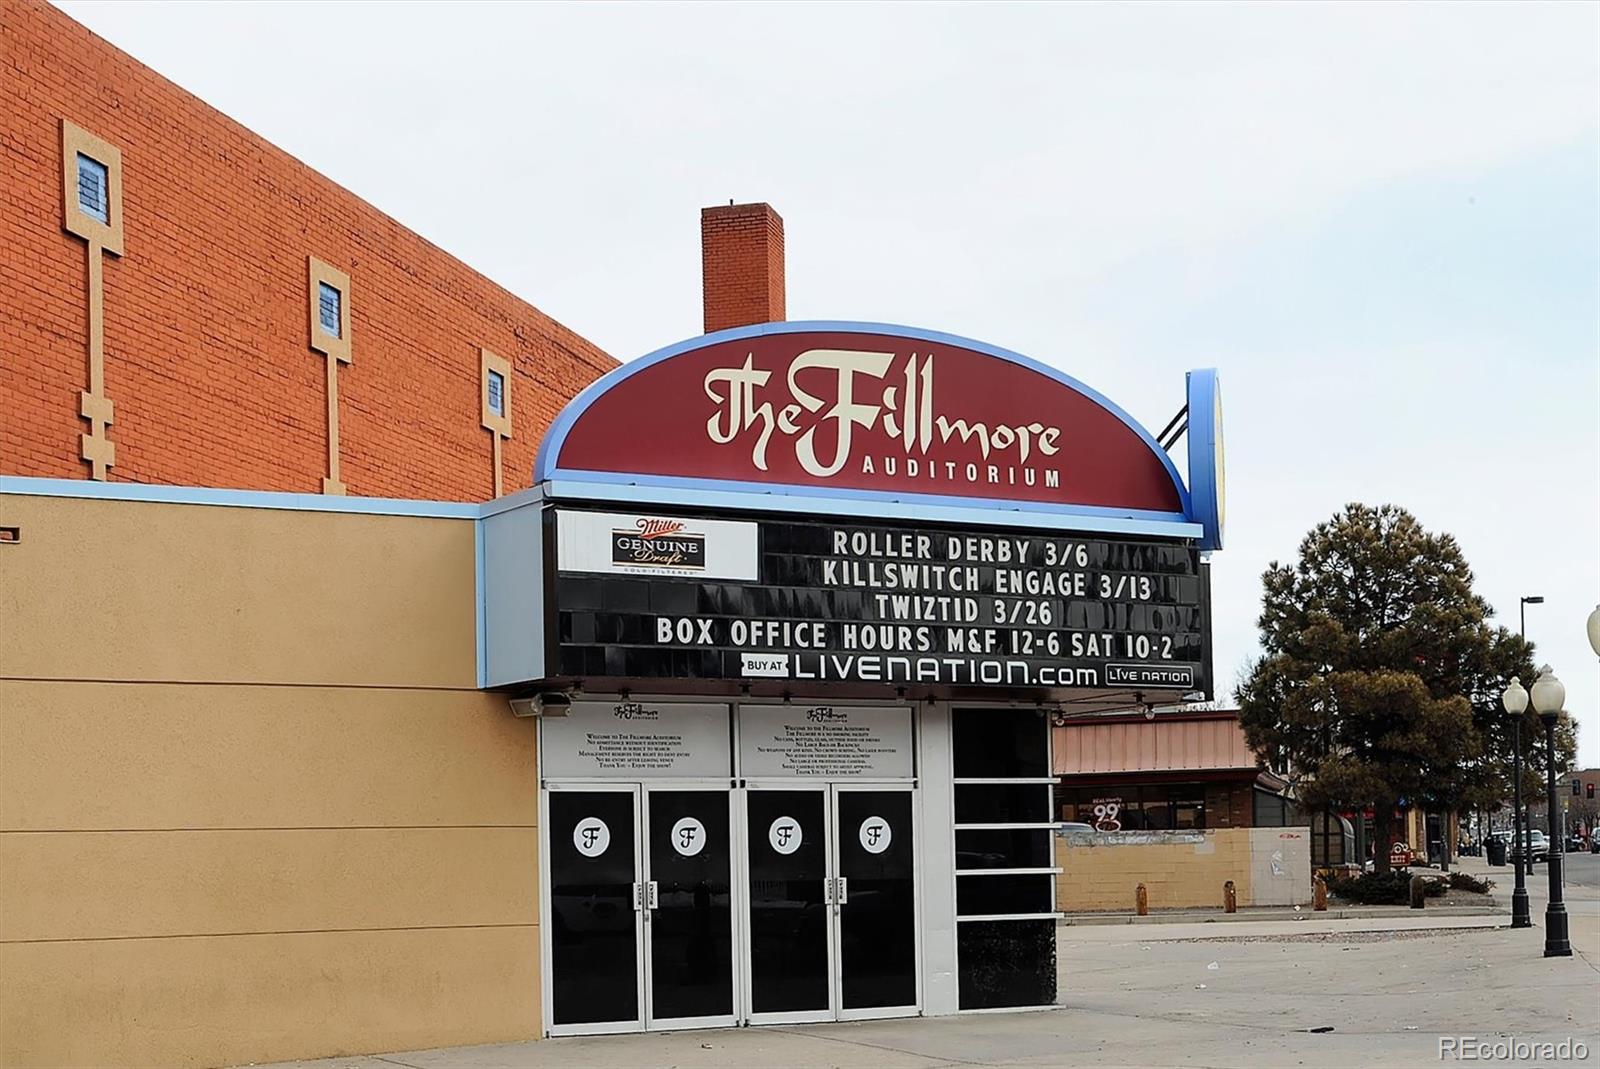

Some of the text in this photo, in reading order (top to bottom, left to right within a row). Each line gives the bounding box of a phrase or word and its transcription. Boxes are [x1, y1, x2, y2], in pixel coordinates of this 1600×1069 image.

[704, 349, 1061, 477] The Fillmore
[862, 455, 1060, 488] AUDITORIUM
[636, 518, 684, 537] Miller
[617, 538, 699, 553] GENUINE
[833, 531, 1088, 568] ROLLER DERBY 3/6
[634, 550, 683, 566] Draft
[823, 560, 1152, 600] KILLSWITCH ENGAGE 3/13
[875, 594, 1052, 626] TWIZTID 3/26
[657, 617, 1173, 659] BOX OFFICE HOURS M&F 12-6 SAT 10-2
[747, 660, 769, 671] BUY
[770, 661, 783, 671] AT
[581, 827, 601, 849] F
[679, 827, 698, 849] F
[776, 826, 794, 847] F
[866, 826, 884, 847] F
